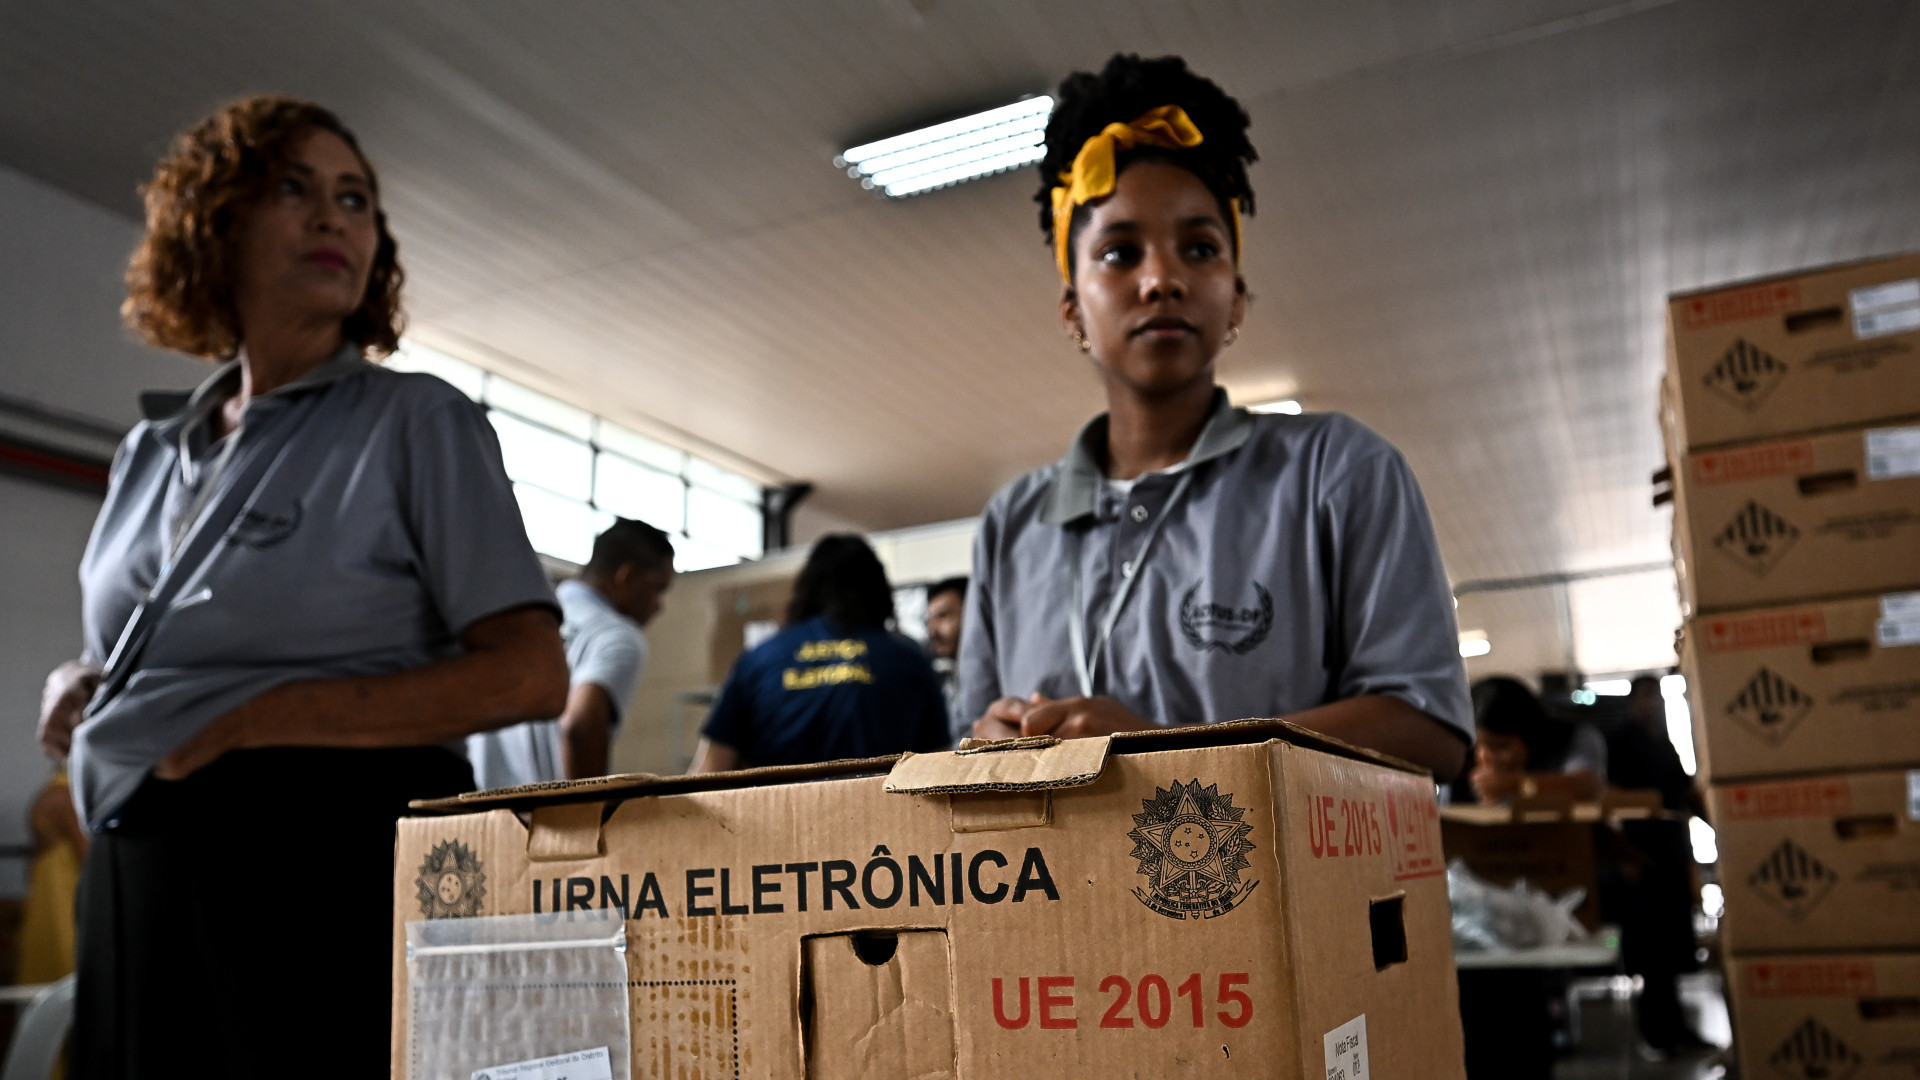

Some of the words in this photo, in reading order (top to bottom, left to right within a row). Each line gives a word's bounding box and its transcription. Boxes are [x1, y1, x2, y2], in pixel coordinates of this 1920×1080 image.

[1307, 794, 1339, 859] UE
[1341, 798, 1382, 856] 2015
[533, 872, 670, 925] URNA
[685, 844, 1061, 918] ELETRÔNICA
[990, 976, 1078, 1030] UE
[1098, 972, 1255, 1030] 2015
[1334, 1040, 1347, 1058] Nota
